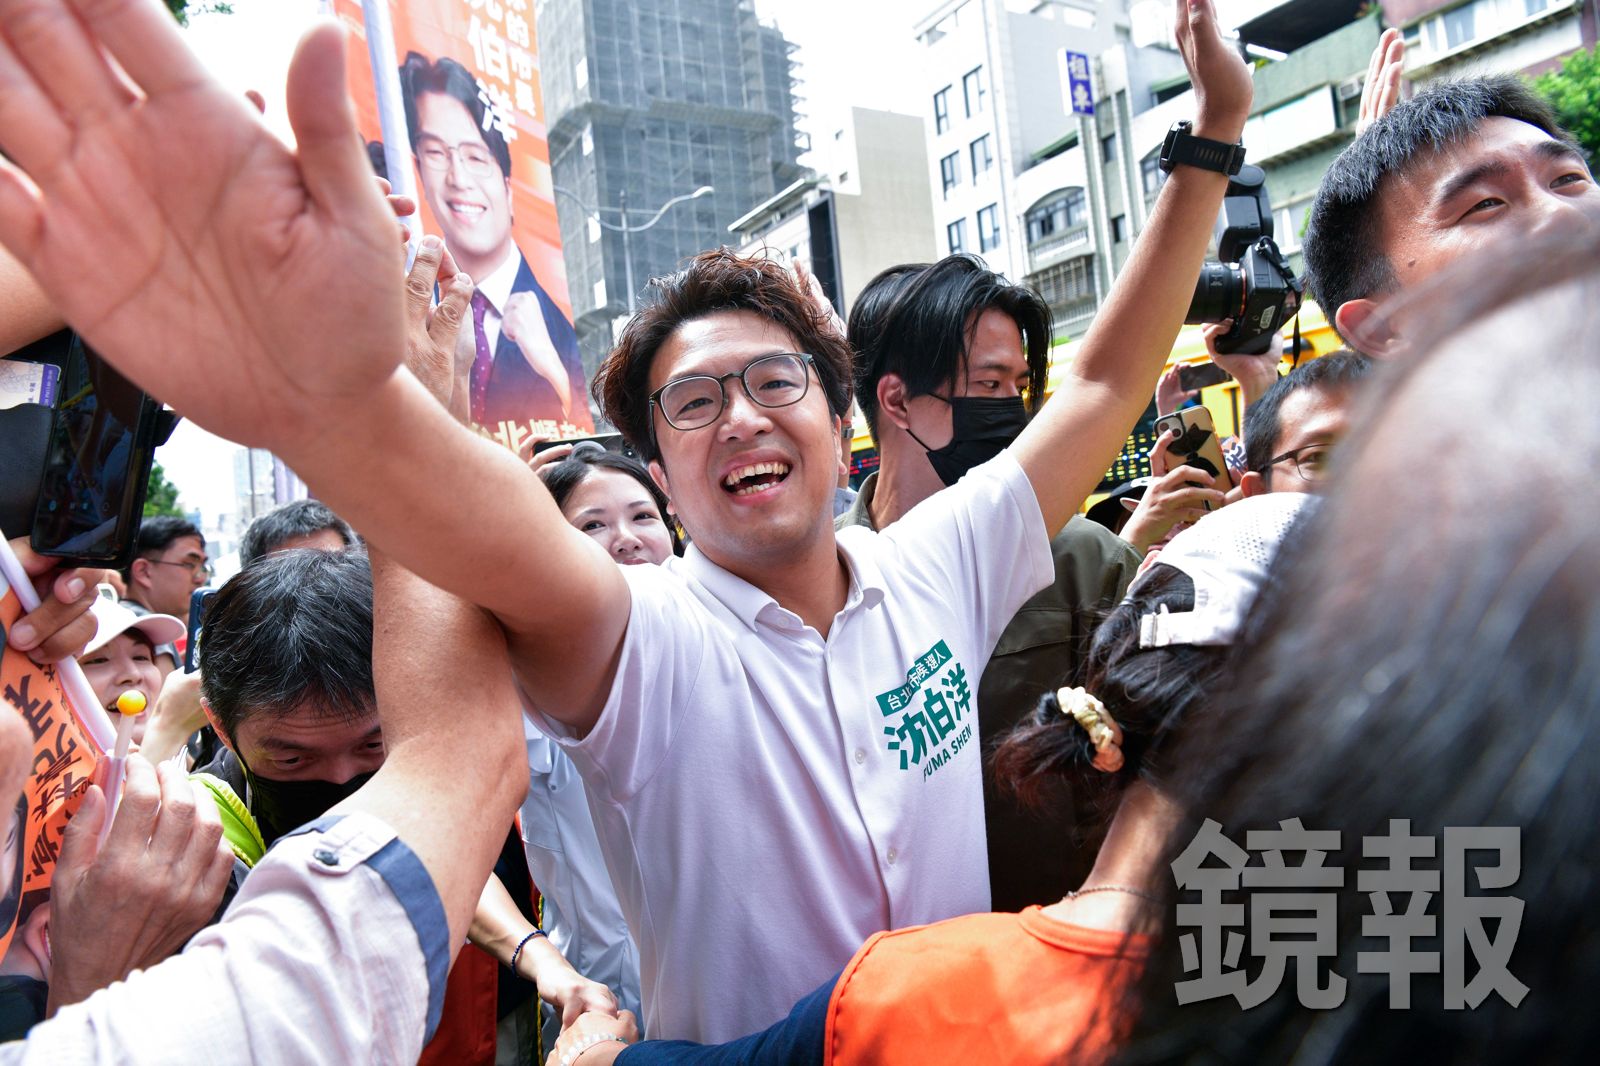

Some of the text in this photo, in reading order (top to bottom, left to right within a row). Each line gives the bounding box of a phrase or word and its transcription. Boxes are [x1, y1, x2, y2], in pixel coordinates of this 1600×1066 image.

[883, 662, 972, 771] 沈伯洋
[922, 723, 973, 783] FUMA SHEN
